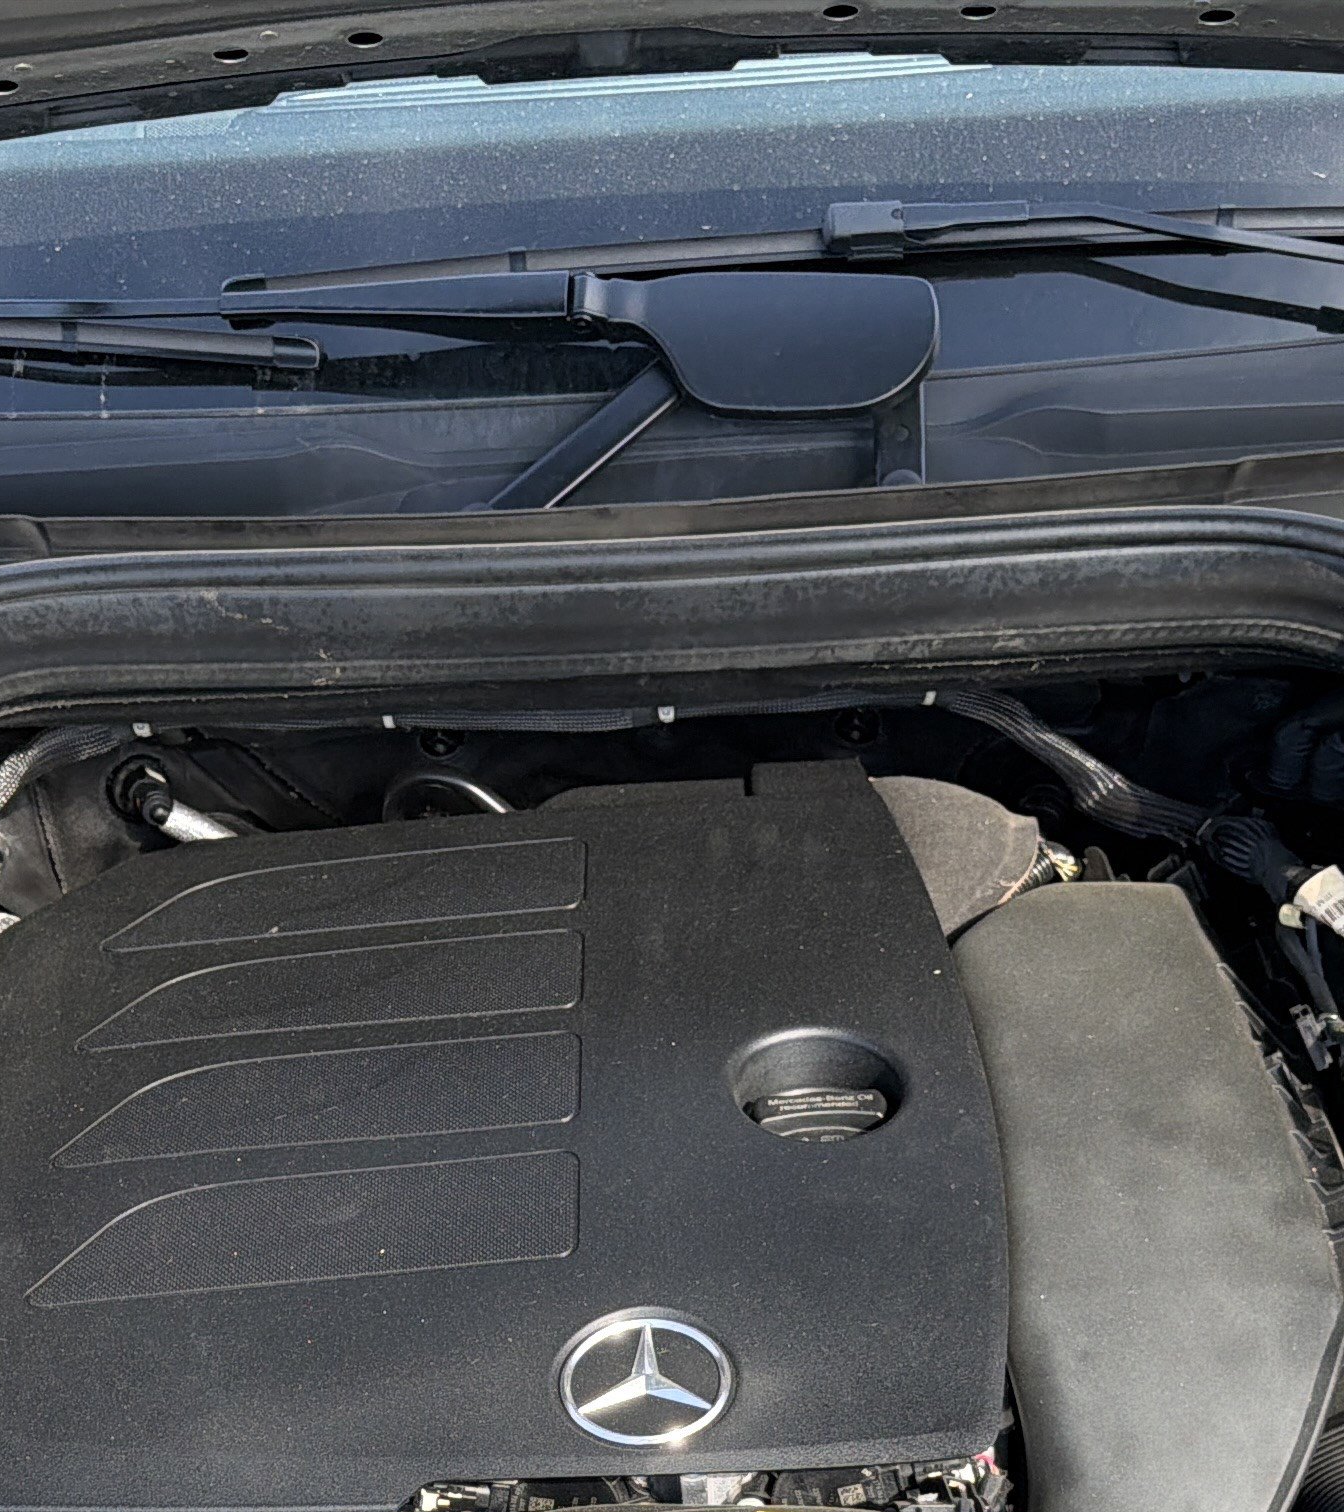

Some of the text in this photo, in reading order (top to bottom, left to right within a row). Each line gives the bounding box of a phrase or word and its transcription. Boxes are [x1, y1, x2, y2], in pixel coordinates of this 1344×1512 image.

[767, 1093, 874, 1106] Mercedes-Benz Oil
[779, 1101, 859, 1111] recommended
